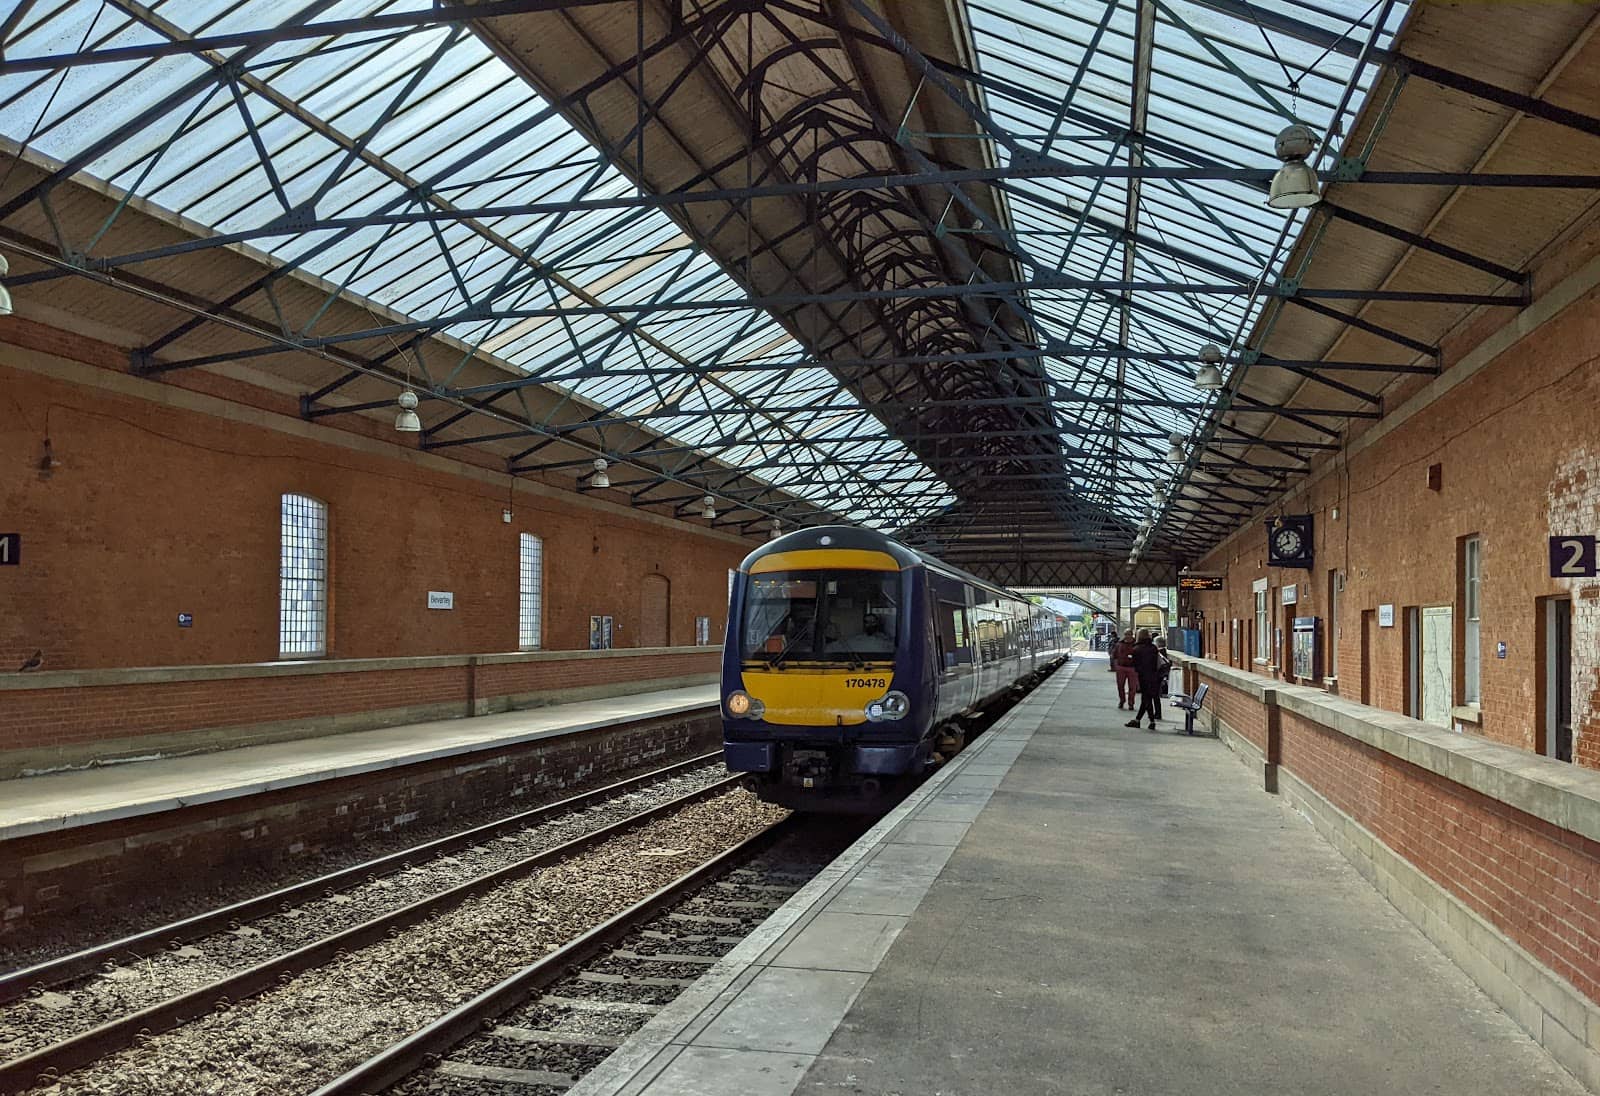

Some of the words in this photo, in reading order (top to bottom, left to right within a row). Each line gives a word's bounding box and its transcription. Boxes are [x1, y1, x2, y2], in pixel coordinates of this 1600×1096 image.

[0, 536, 9, 562] 1
[1561, 540, 1585, 573] 2
[1196, 611, 1202, 619] 2
[845, 678, 886, 688] 170478
